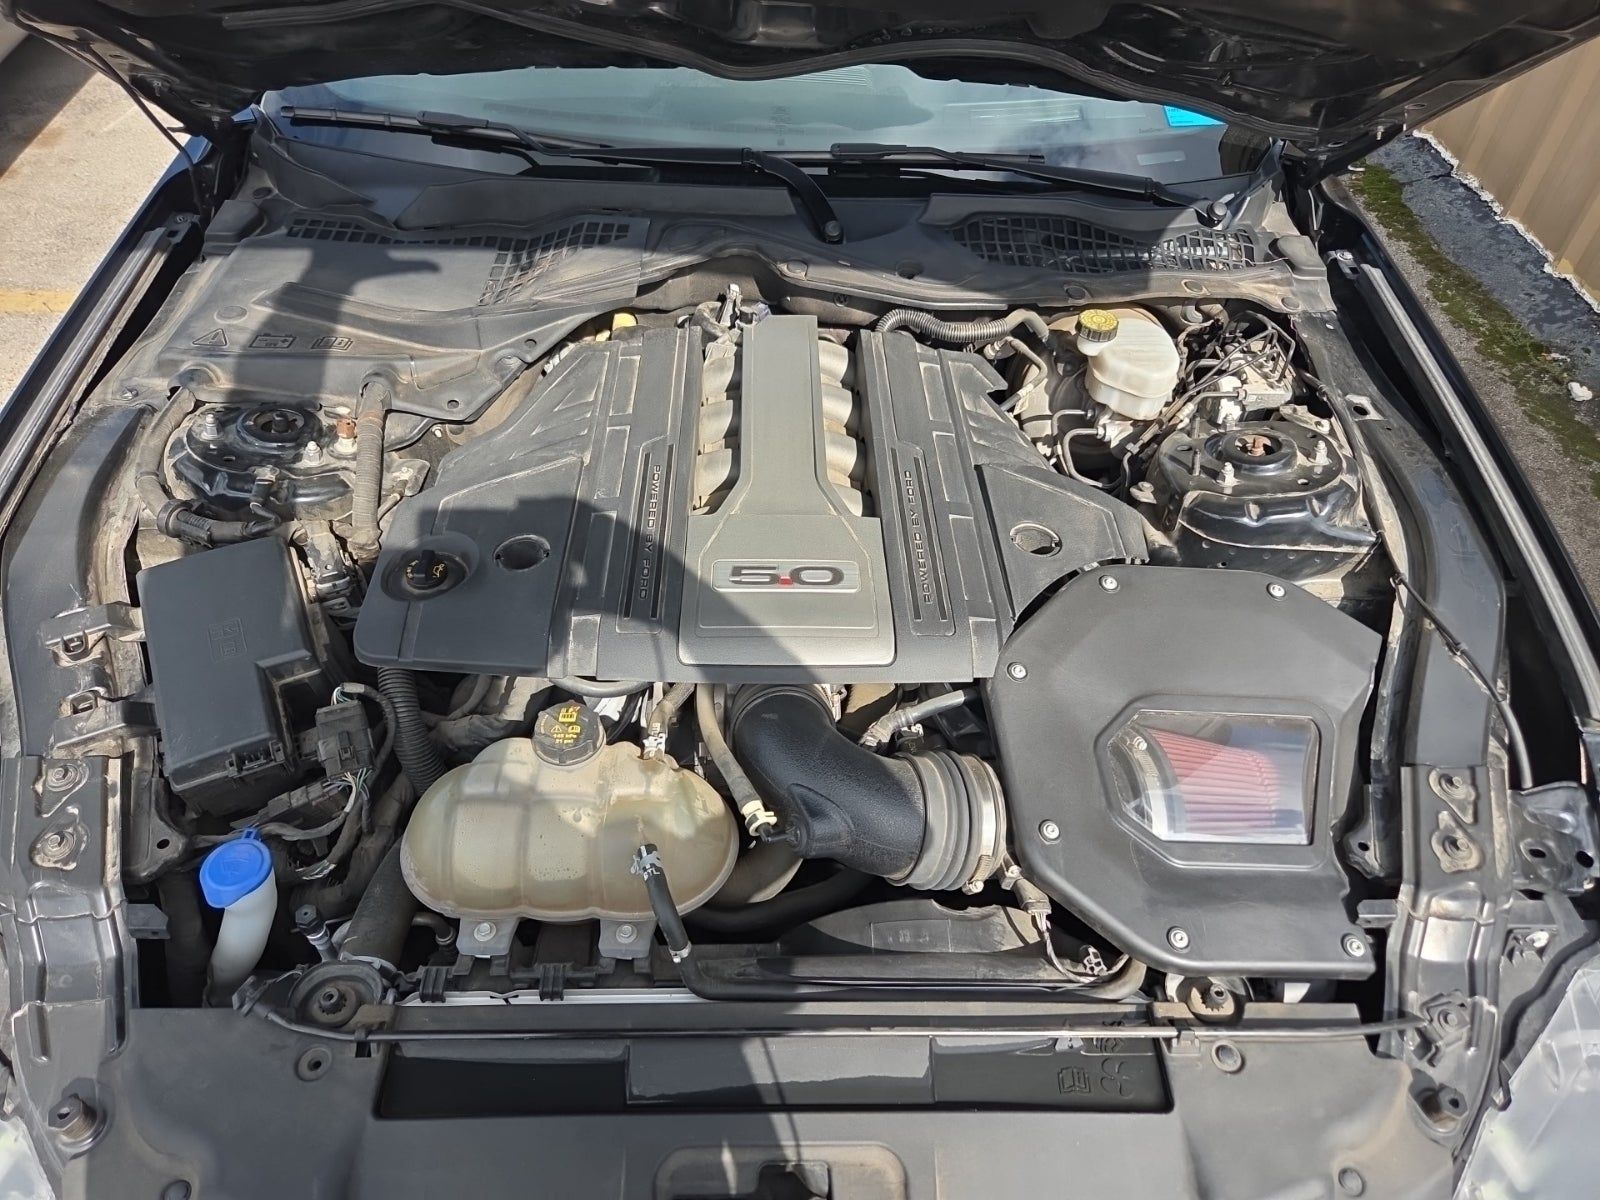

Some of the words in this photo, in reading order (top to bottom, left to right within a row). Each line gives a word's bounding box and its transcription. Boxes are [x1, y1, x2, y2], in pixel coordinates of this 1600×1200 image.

[647, 464, 661, 529] POWERED
[904, 470, 916, 505] FORD
[909, 508, 920, 528] BY
[644, 534, 653, 553] BY
[640, 559, 651, 600] FORD
[728, 564, 846, 586] 5.0
[913, 532, 933, 604] POWERED
